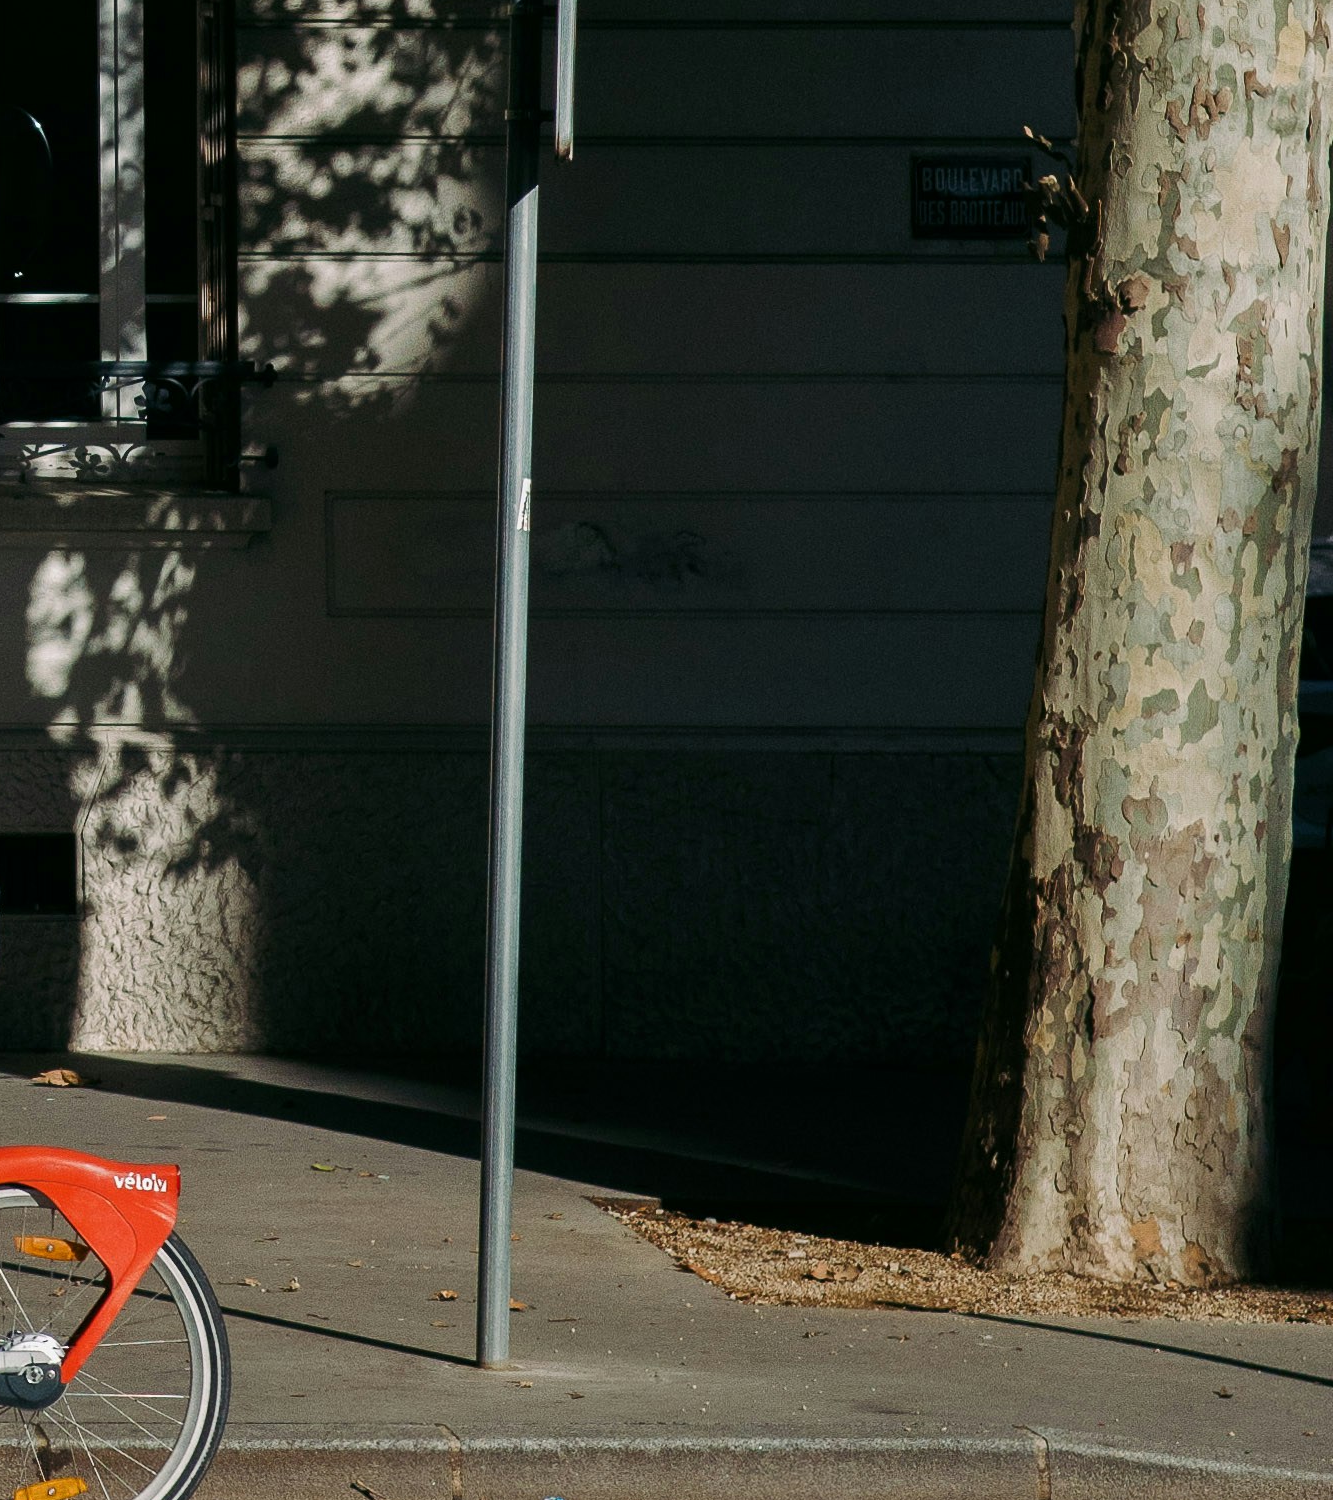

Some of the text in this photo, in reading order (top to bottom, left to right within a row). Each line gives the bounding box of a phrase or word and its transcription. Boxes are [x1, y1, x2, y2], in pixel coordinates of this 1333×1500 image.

[923, 167, 1023, 192] BOULEVARD
[919, 200, 1027, 225] DES BROTTEAUX
